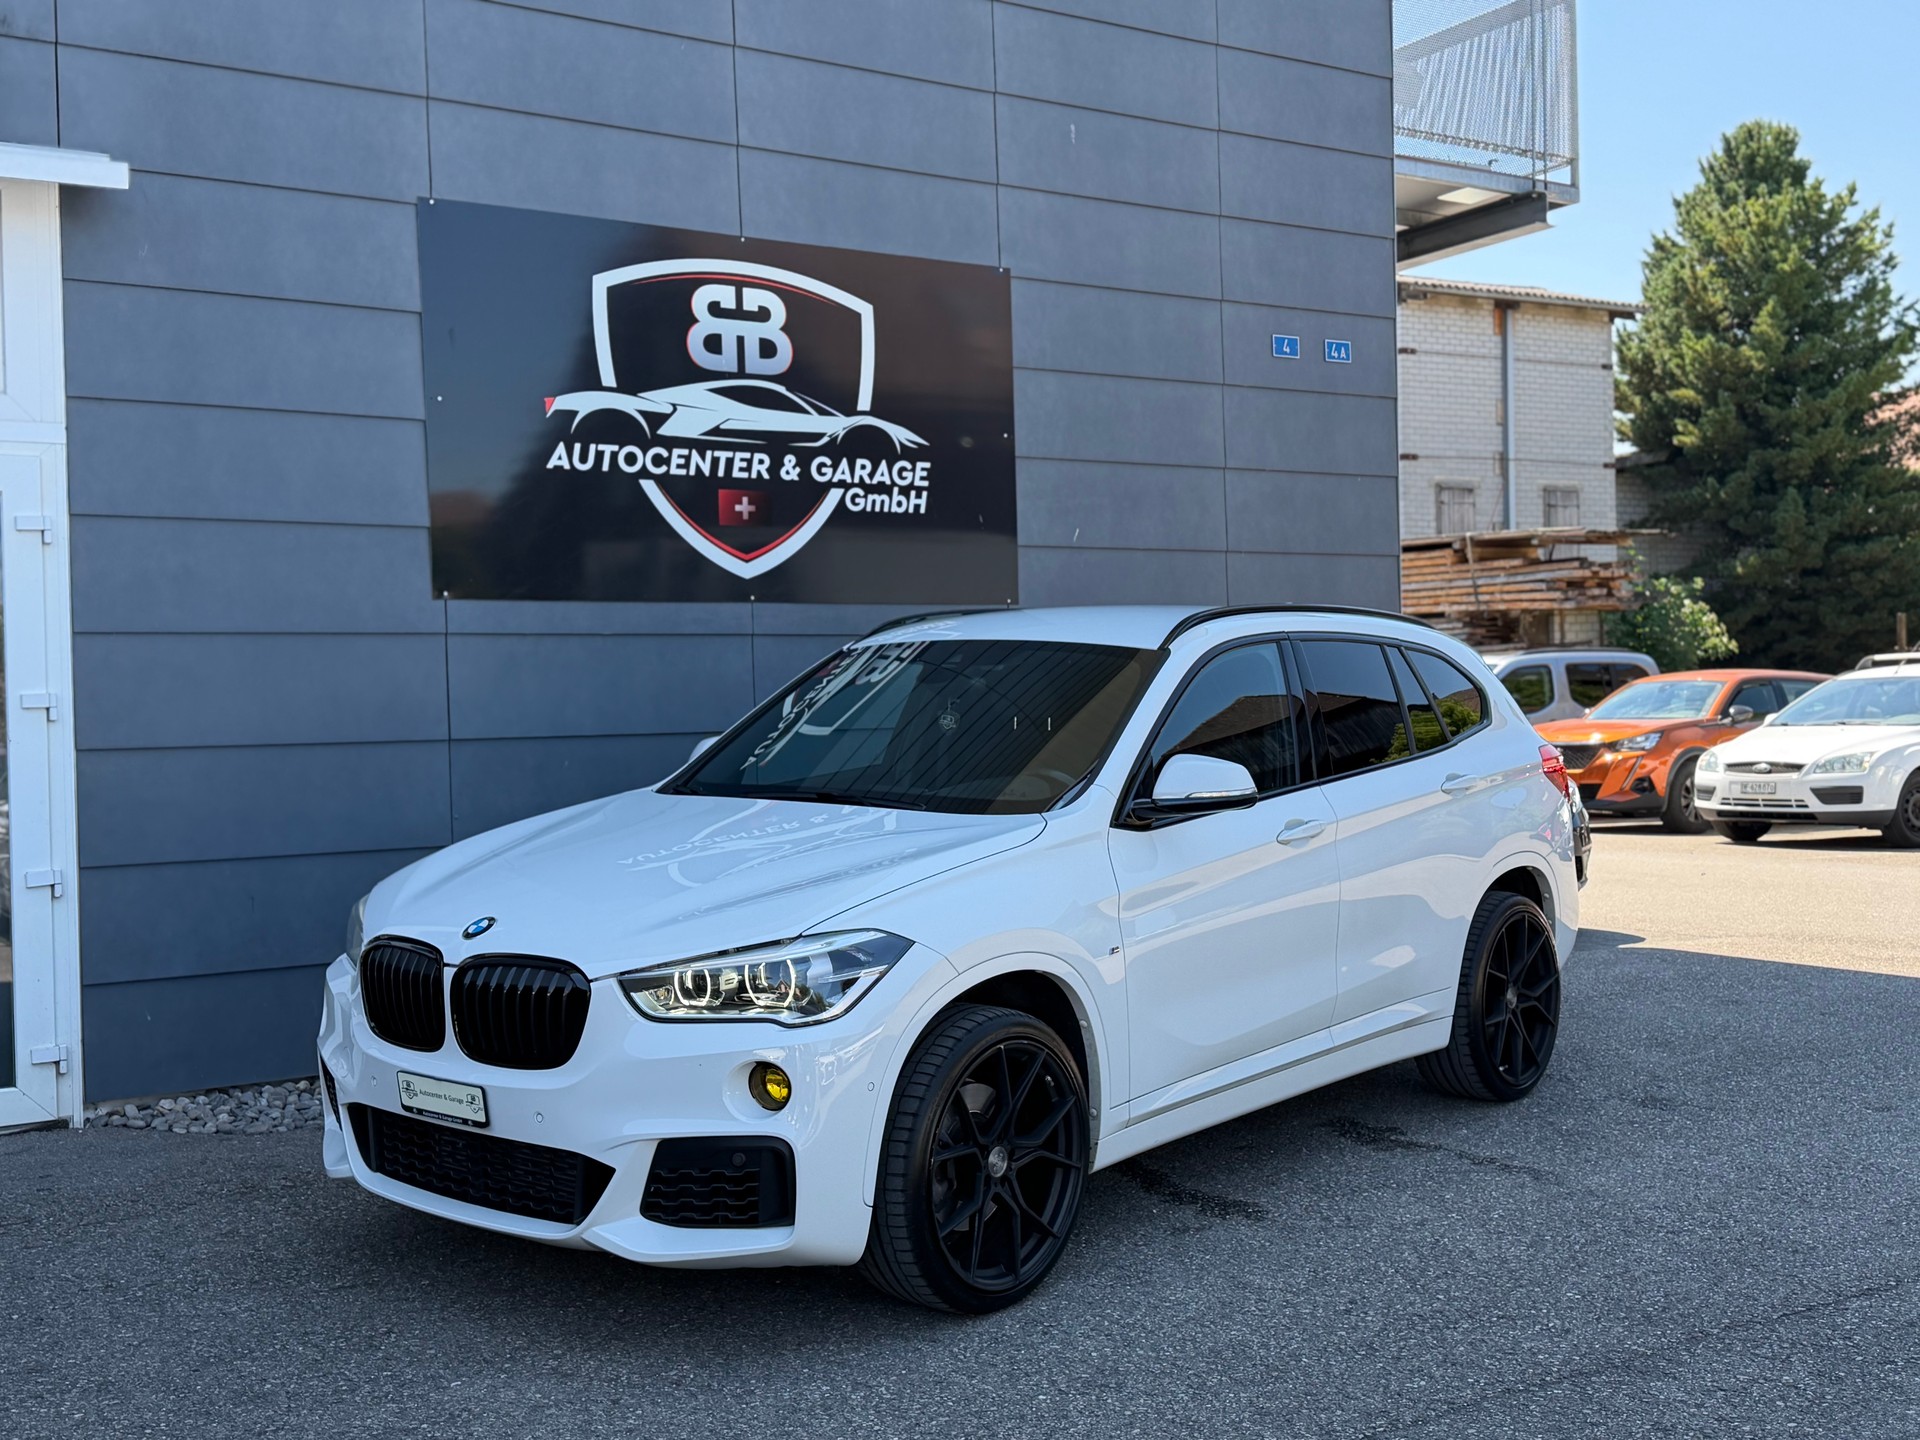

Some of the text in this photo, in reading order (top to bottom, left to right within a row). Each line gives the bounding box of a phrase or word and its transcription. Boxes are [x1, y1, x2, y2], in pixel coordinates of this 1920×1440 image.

[1283, 338, 1291, 354] 4
[1331, 343, 1347, 359] 4A
[546, 441, 932, 487] AUTOCENTER & GARAGE
[845, 486, 928, 514] GmbH
[420, 1089, 443, 1099] Autocenter
[448, 1095, 464, 1104] Garage
